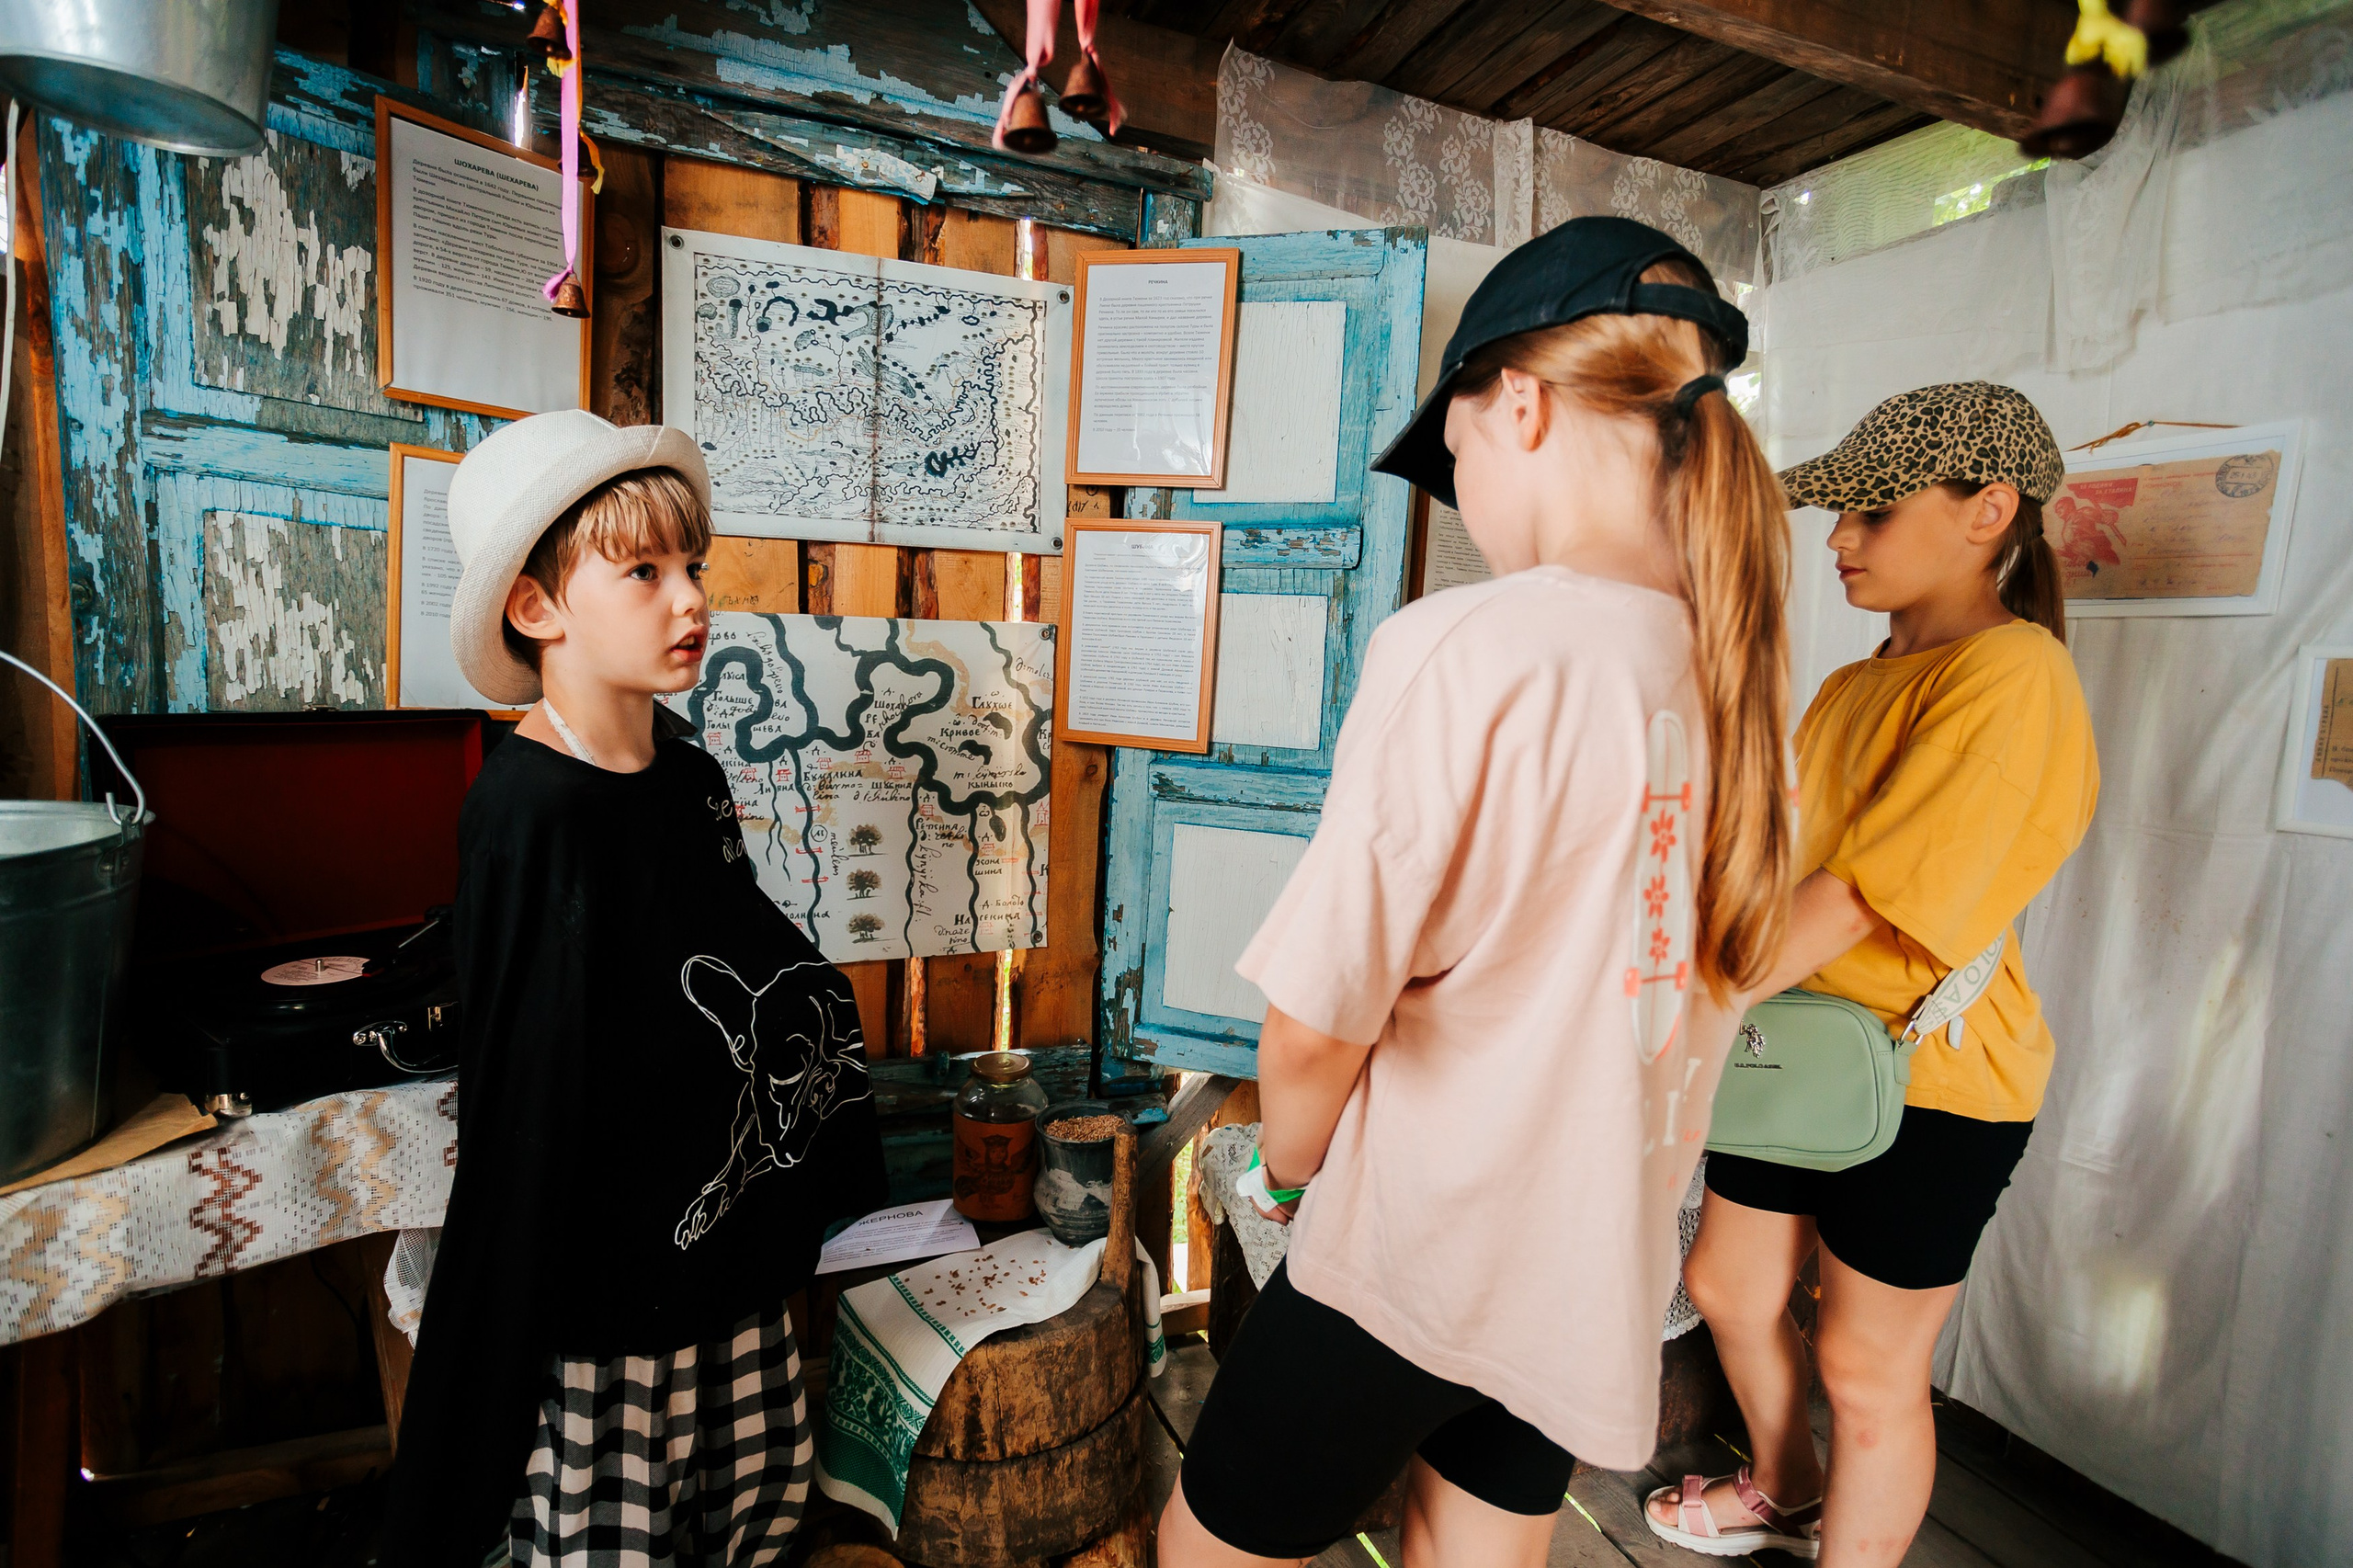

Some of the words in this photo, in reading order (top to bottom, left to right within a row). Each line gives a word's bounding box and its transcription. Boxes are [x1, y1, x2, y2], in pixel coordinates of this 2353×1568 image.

[413, 158, 438, 170] Деревня
[438, 167, 452, 176] была
[453, 173, 478, 184] основана
[512, 190, 535, 200] Первыми
[413, 167, 428, 176] были
[429, 172, 458, 186] Шехаревы
[467, 182, 501, 199] Центральной
[502, 195, 520, 204] России
[454, 158, 494, 176] ШОХАРЕВА
[496, 172, 539, 191] (ШЕХАРЕВА)
[413, 196, 445, 208] крестьянин
[446, 205, 471, 217] Михайло
[472, 211, 491, 222] Петров
[417, 189, 445, 200] дозорной
[447, 197, 461, 206] книге
[463, 202, 494, 216] Тюменского
[496, 212, 510, 221] уезда
[413, 211, 431, 221] Пашет
[452, 223, 469, 232] вдоль
[467, 220, 485, 230] города
[487, 224, 507, 235] Тюмени
[509, 232, 524, 240] после
[417, 225, 438, 233] списке
[438, 232, 471, 244] населенных
[485, 243, 515, 256] Тобольской
[516, 252, 540, 263] губернии
[469, 246, 495, 258] Шехарева
[436, 254, 460, 264] деревне
[460, 261, 480, 269] дворов
[494, 270, 520, 280] население
[452, 251, 472, 259] верстах
[481, 258, 499, 267] города
[413, 263, 438, 274] Деревня
[438, 270, 460, 281] входила
[466, 278, 483, 286] состав
[419, 277, 432, 285] 1920
[433, 280, 445, 289] году
[450, 285, 472, 294] деревне
[493, 276, 515, 287] Имеется
[414, 283, 445, 295] проживали
[858, 1210, 923, 1226] ЖЕРНОВА
